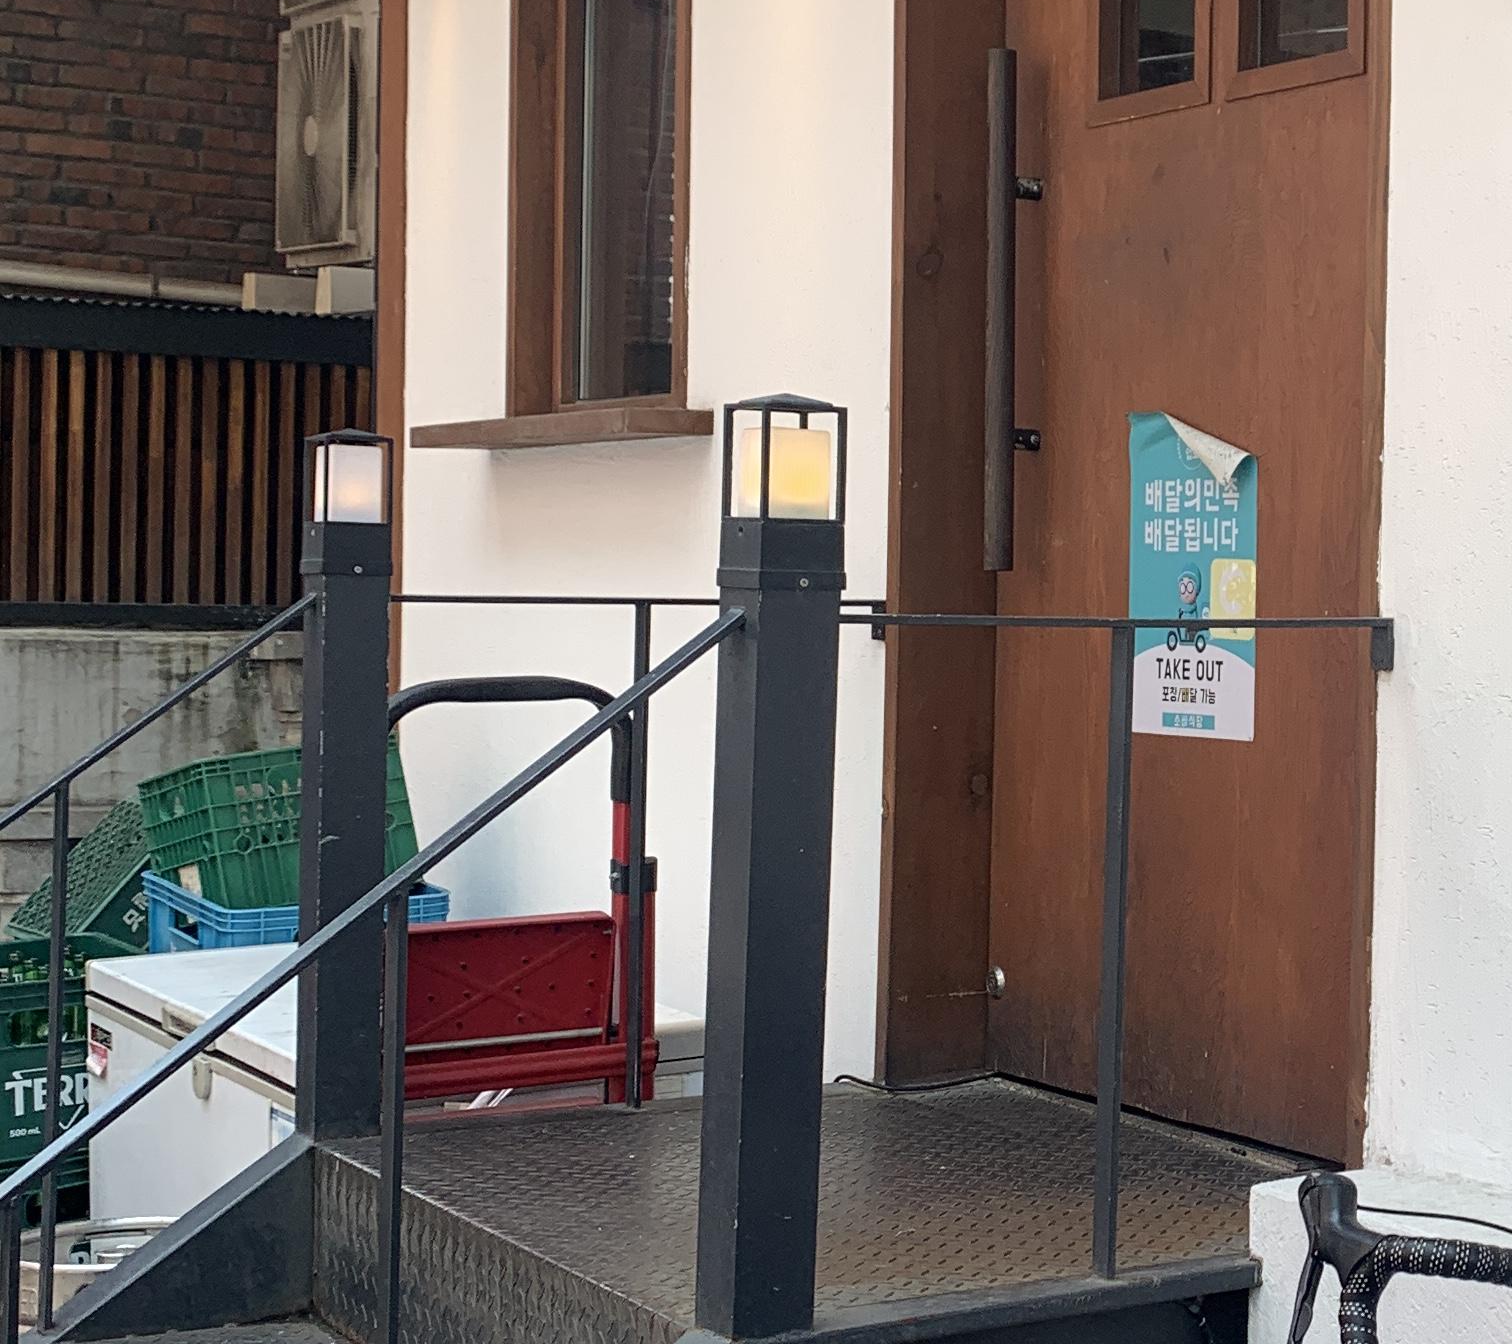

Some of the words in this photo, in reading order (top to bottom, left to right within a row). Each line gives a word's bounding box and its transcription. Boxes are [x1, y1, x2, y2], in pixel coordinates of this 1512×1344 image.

[1144, 477, 1240, 513] 배달의민족
[1143, 517, 1240, 553] 배달됩니다
[1155, 657, 1191, 681] TAKE
[1195, 659, 1224, 682] OUT
[1200, 688, 1216, 705] 가능
[9, 1128, 27, 1138] 500
